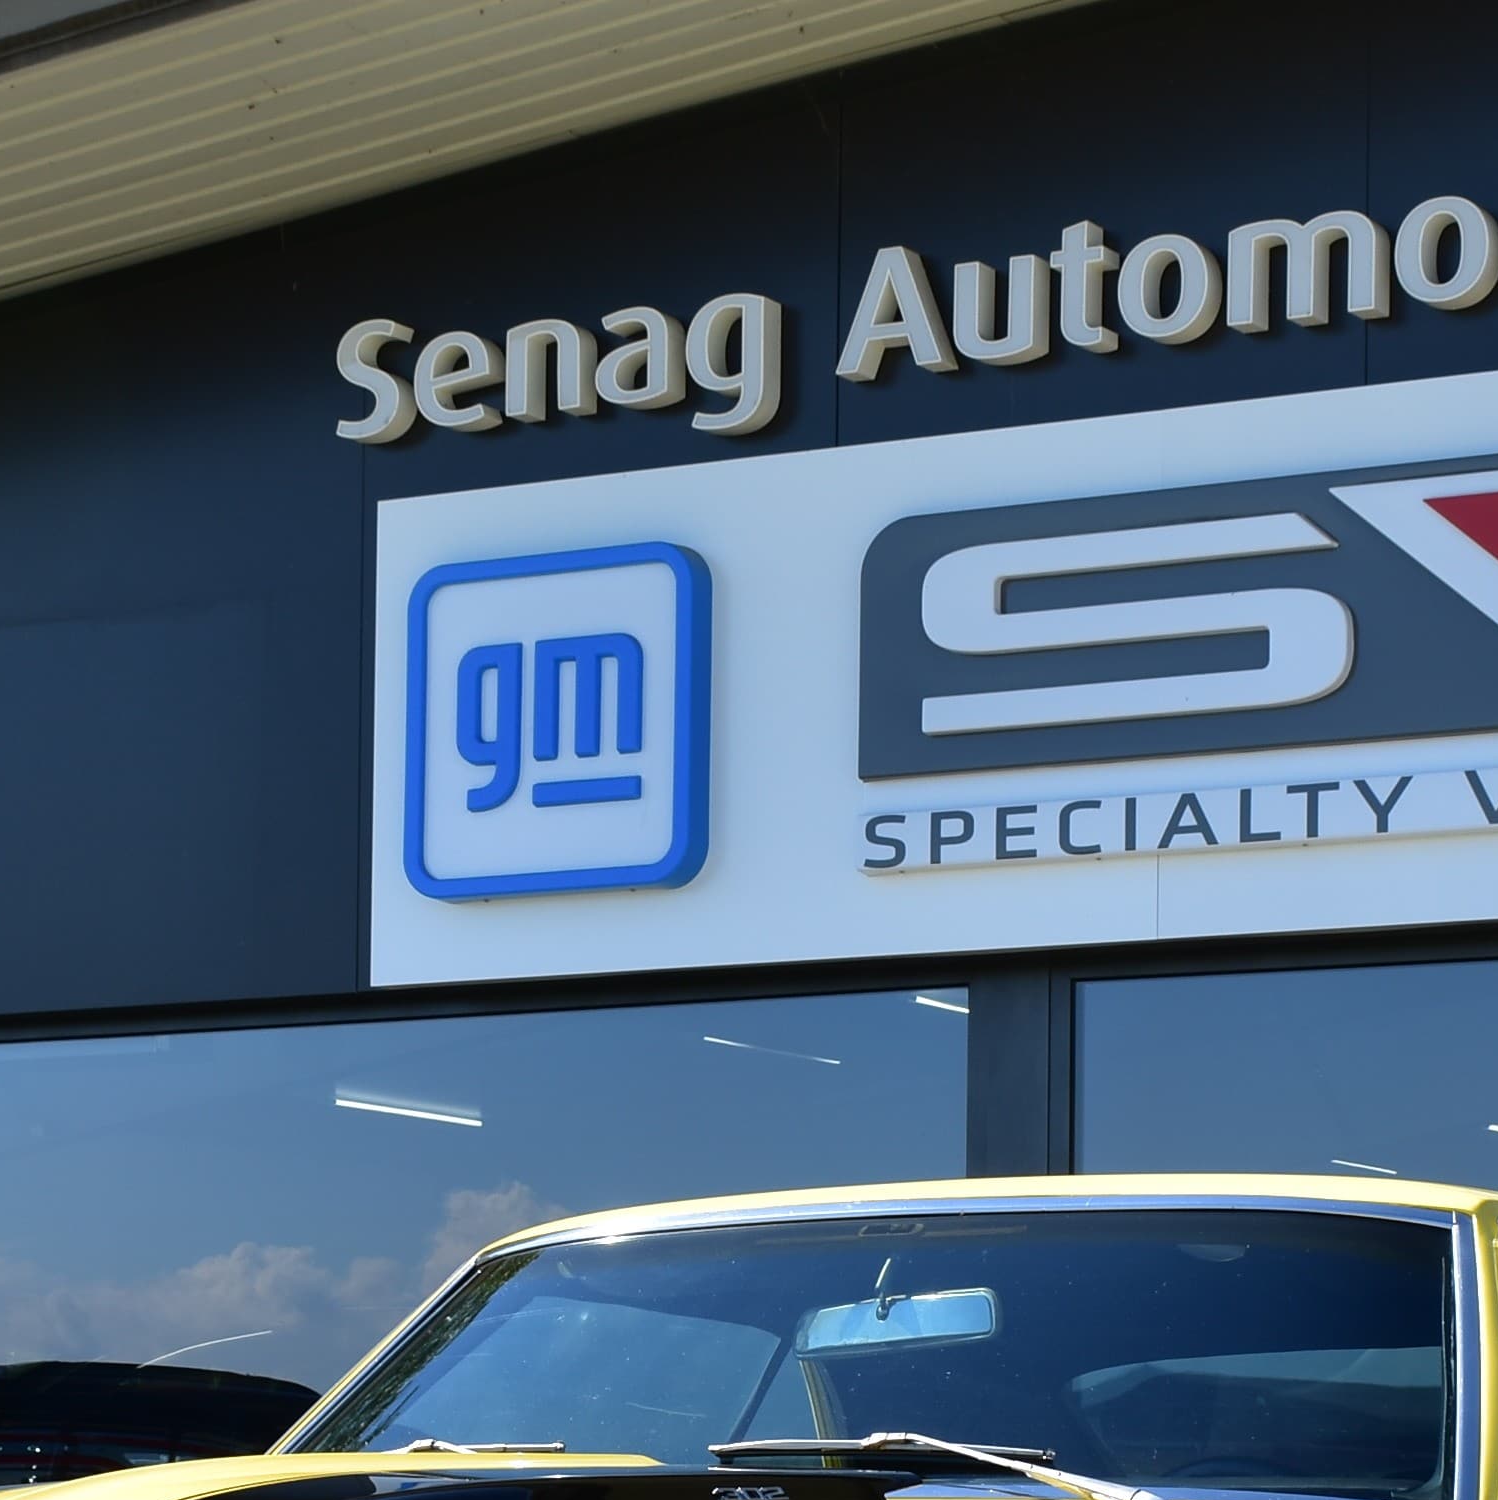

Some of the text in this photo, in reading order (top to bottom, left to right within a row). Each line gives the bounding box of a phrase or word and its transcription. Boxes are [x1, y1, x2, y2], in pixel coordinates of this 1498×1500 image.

[335, 292, 782, 444] Senag
[456, 632, 643, 813] gm
[863, 776, 1413, 870] SPECIALTY
